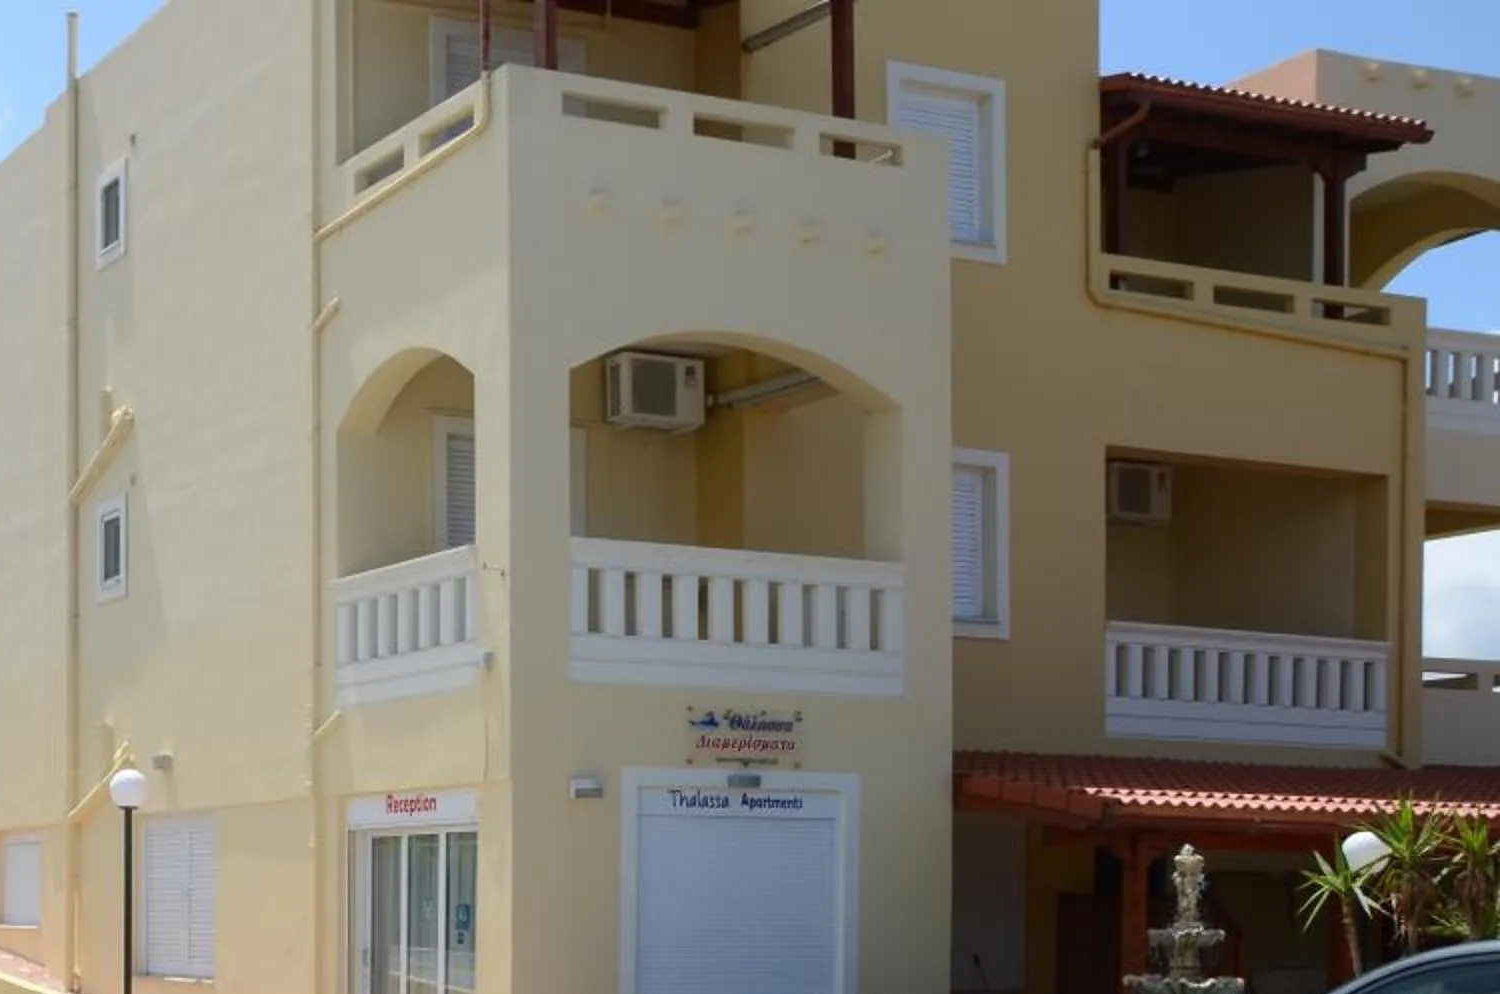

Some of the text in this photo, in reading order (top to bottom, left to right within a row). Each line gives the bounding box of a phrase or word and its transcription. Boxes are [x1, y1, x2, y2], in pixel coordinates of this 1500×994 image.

[386, 793, 438, 816] Reception
[668, 788, 804, 811] Thalassa Apartments
